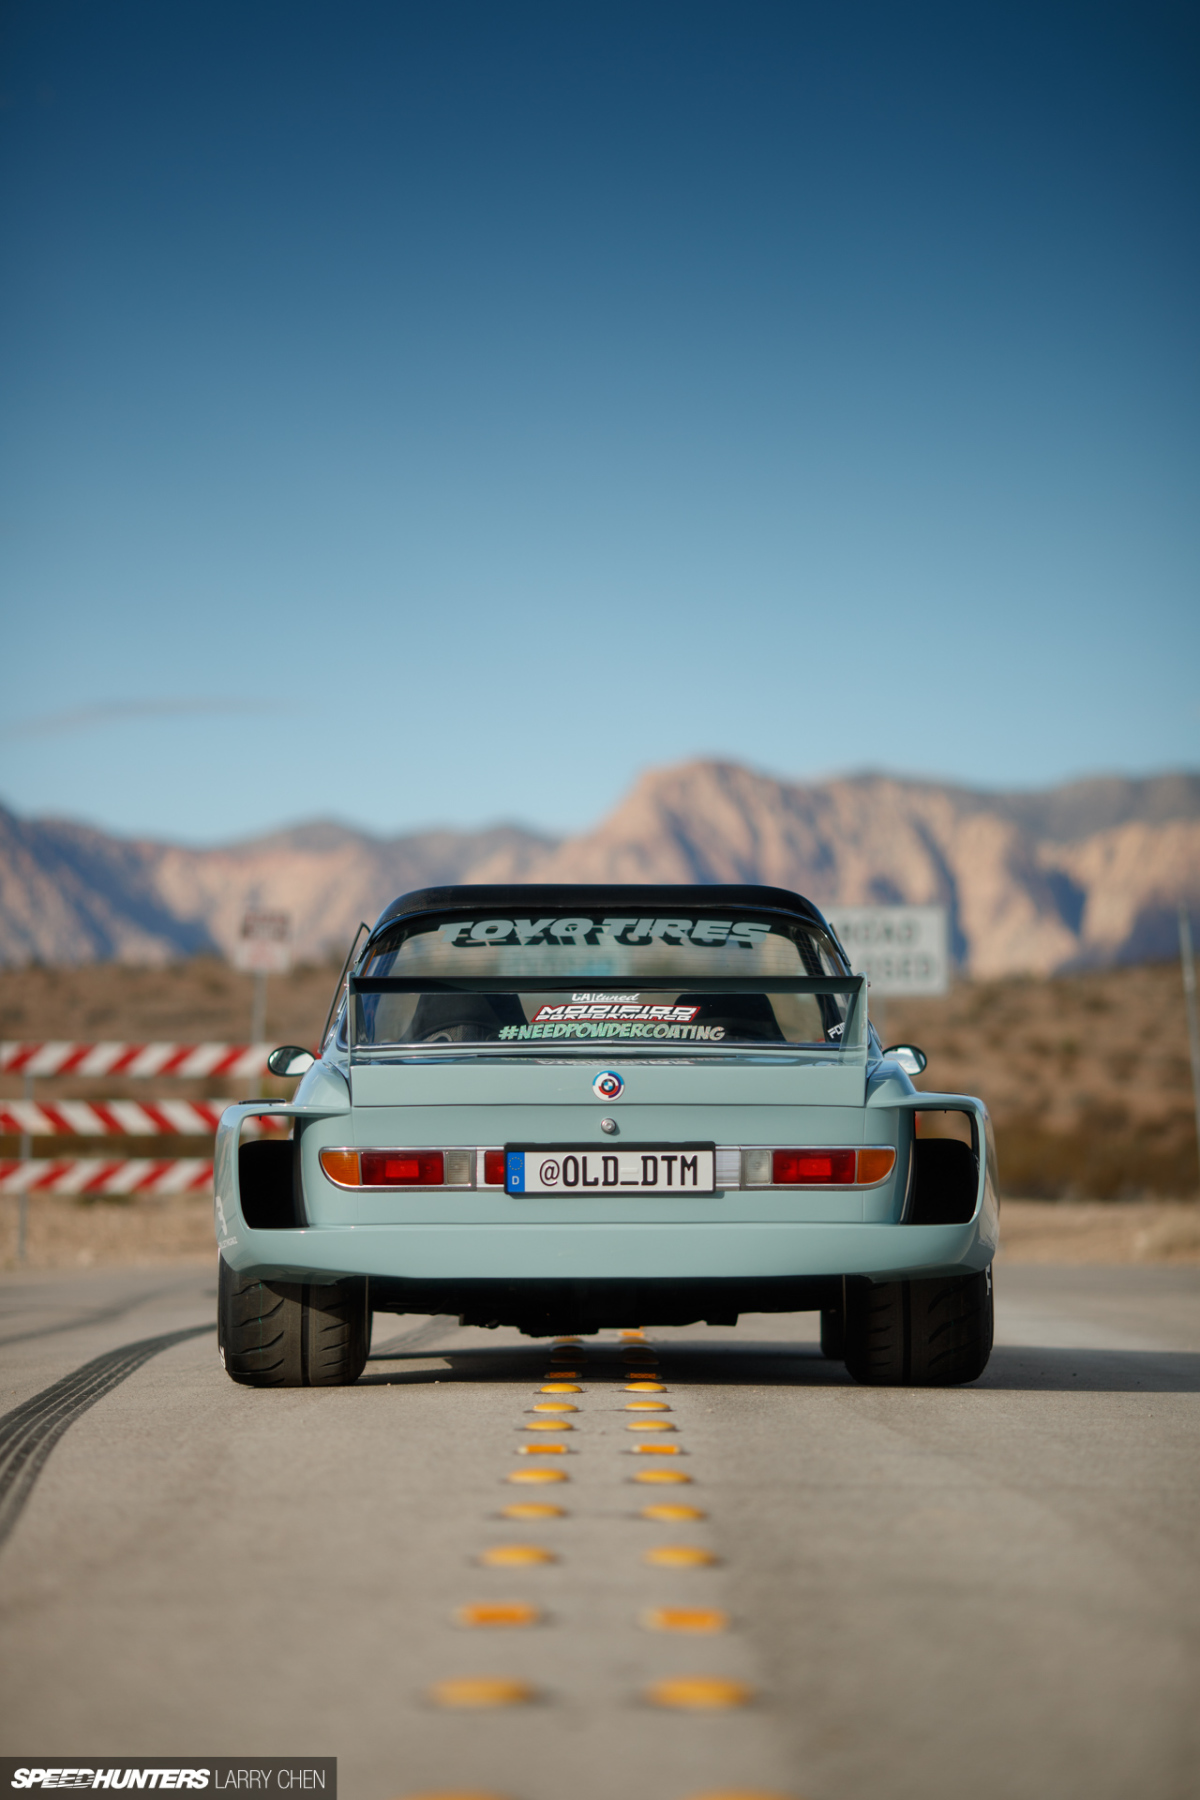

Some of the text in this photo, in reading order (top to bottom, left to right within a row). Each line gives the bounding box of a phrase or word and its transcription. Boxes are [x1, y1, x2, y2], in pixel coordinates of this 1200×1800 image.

[437, 918, 772, 944] TOYO TIRES
[535, 1013, 692, 1021] PERFORMANCE
[498, 1022, 725, 1041] #NEEDPOWDERCOATING
[511, 1176, 520, 1185] D
